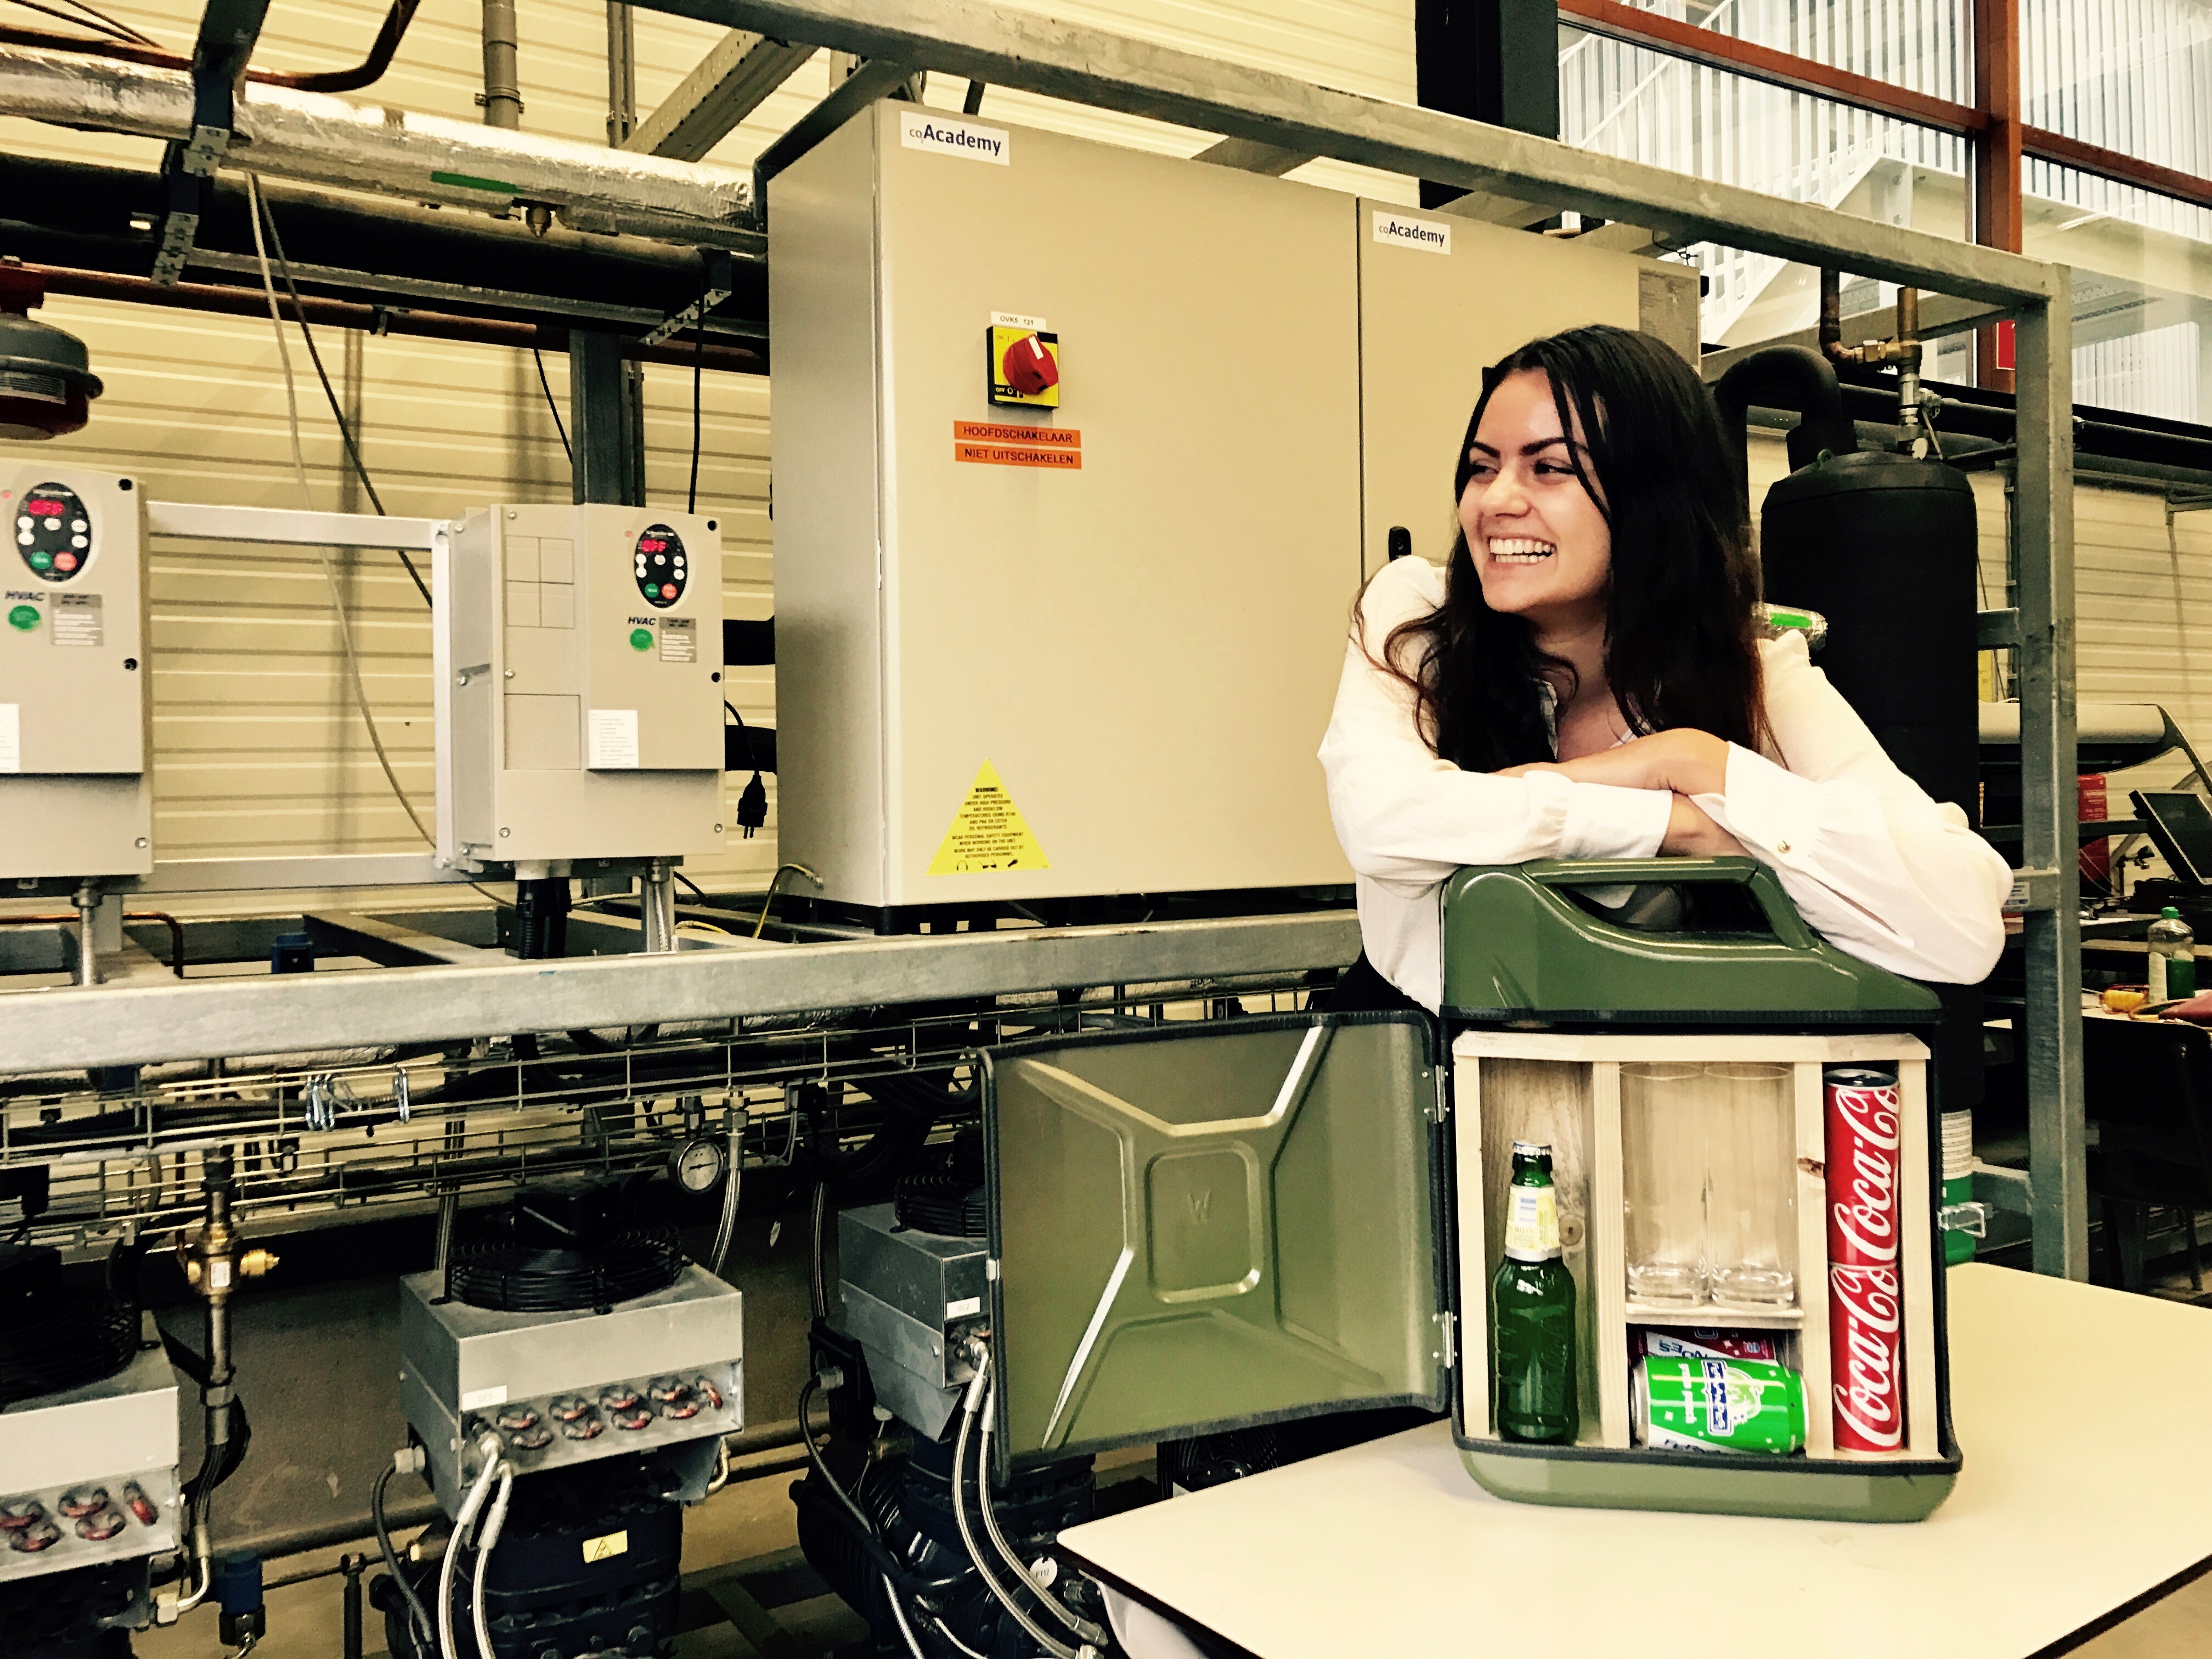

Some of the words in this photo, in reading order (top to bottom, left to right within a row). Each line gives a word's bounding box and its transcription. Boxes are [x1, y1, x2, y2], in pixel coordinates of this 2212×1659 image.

[963, 426, 1073, 443] HOOFDSCHAKELAAR
[964, 448, 989, 459] NIET
[993, 449, 1074, 464] UITSCHAKELEN
[628, 616, 656, 626] HVAC
